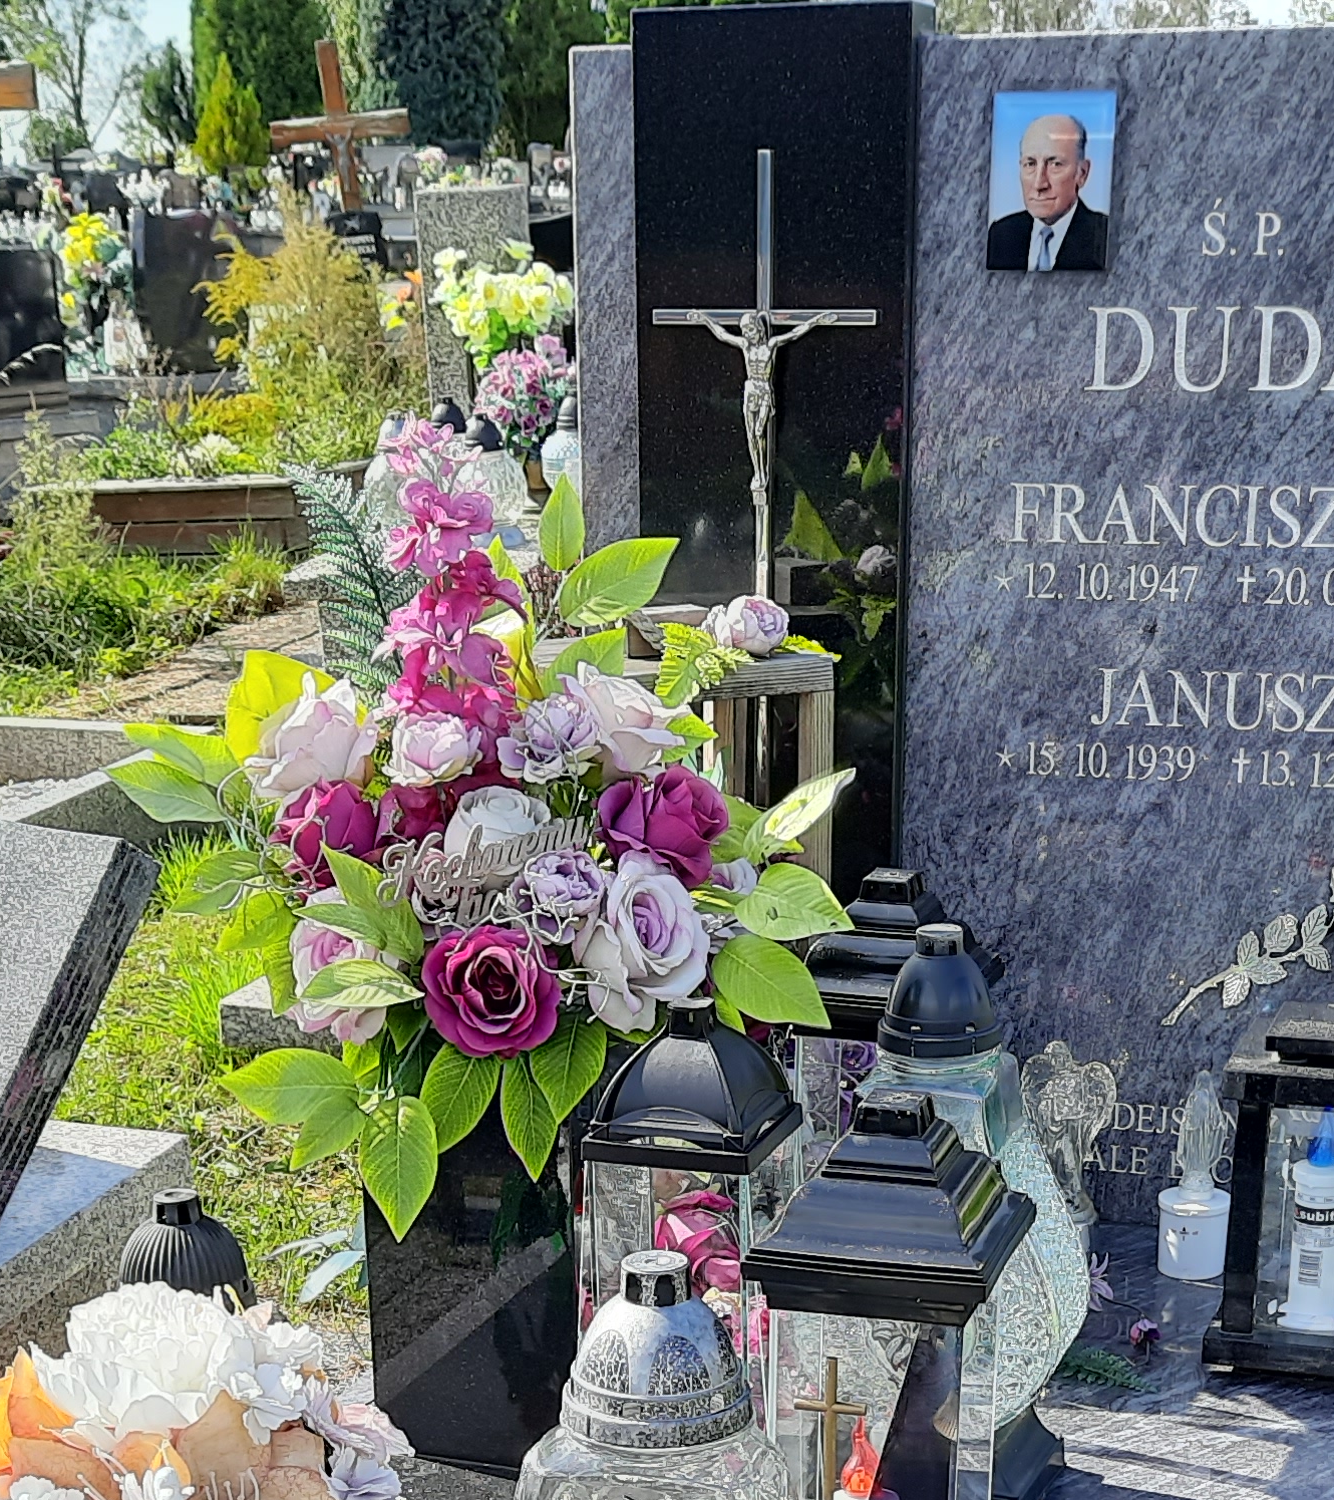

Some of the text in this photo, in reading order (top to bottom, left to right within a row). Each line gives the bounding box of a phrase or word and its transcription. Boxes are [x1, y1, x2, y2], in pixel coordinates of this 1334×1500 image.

[1202, 198, 1286, 257] Ś. P.
[1023, 564, 1062, 600] 12.
[1075, 564, 1114, 602] 10.
[1125, 564, 1200, 604] 1947
[1263, 566, 1311, 607] 20.
[1027, 741, 1060, 777] 15.
[1074, 742, 1111, 780] 10.
[1124, 744, 1197, 782] 1939
[1259, 749, 1296, 787] 13.
[375, 814, 589, 909] Kochanemu
[1083, 1143, 1148, 1175] ALE
